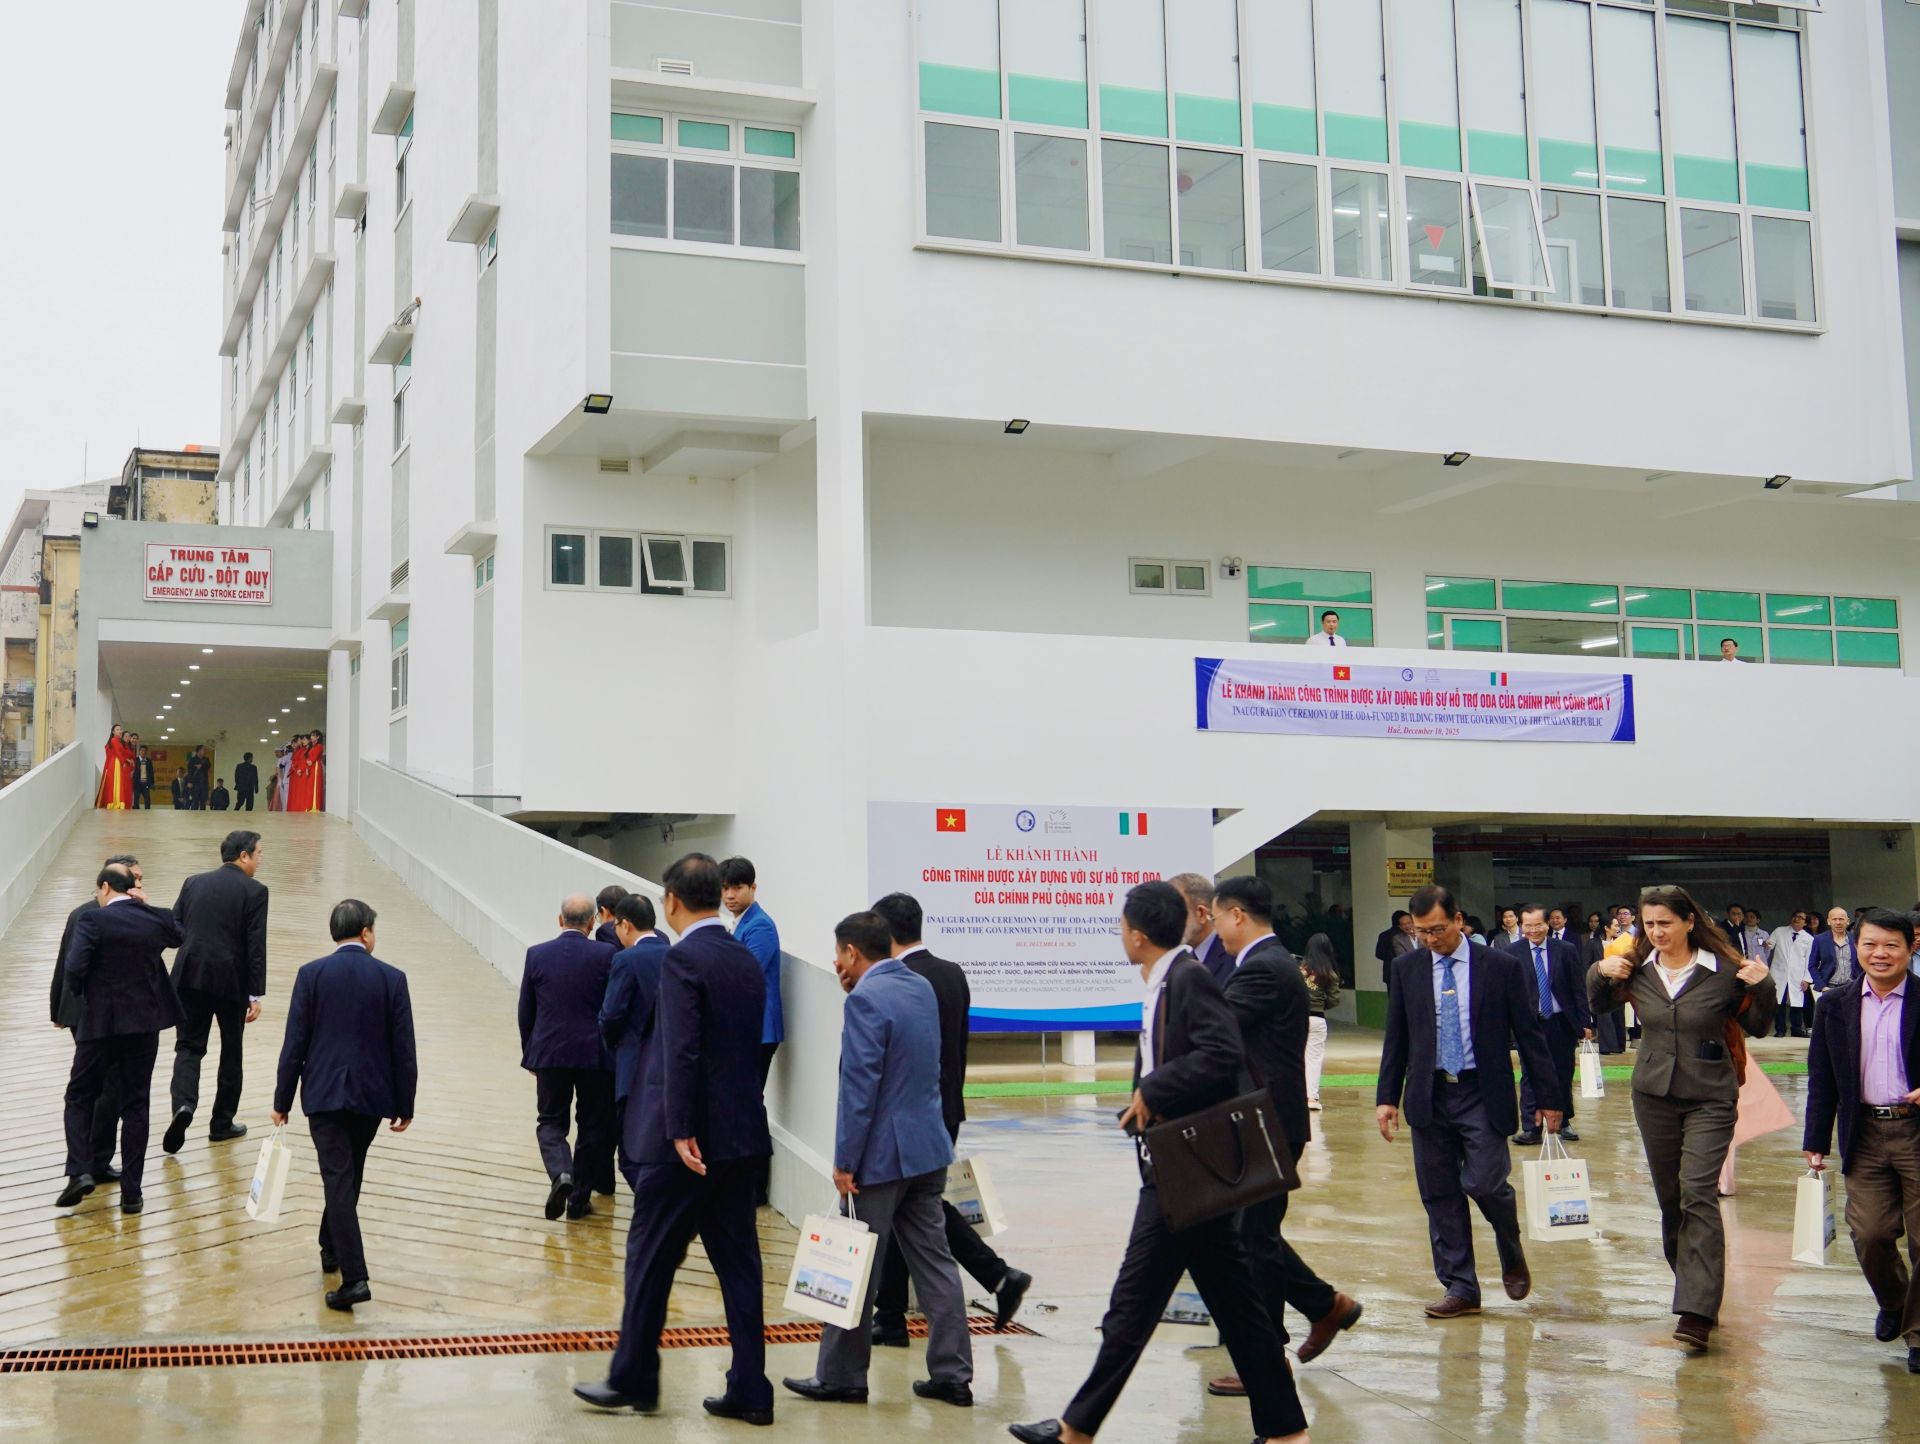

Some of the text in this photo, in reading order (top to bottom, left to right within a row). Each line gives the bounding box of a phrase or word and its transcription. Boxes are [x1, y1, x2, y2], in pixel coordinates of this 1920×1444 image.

[170, 549, 249, 563] TRUNG TÂM
[148, 560, 174, 582] CẤP
[180, 563, 205, 583] CỨU
[216, 566, 240, 588] ĐỘT
[245, 570, 269, 588] QUỴ
[152, 586, 265, 600] EMERGENCY AND STROKE CENTER
[1222, 678, 1611, 713] LỄ KHÁNH THÀNH CÔNG TRÌNH ĐƯỢC XÂY DỰNG VỚI SỰ HỖ TRỢ ODA CỦA CHÍNH PHỦ CỘNG HÒA Ý
[1232, 706, 1604, 727] INAUGURATION CEREMONY OF THE ODA-FUNDED BUILDING FROM THE GOVERNMENT OF THE ITALIAN REPUBLIC
[1403, 726, 1433, 736] December
[1445, 727, 1460, 736] 2025
[1006, 845, 1051, 861] KHÁNH
[1054, 846, 1098, 862] THÀNH
[922, 866, 951, 882] CÔNG
[954, 867, 985, 883] TRÌNH
[987, 869, 1015, 886] ĐƯỢC
[1018, 867, 1037, 883] XÂY
[1040, 869, 1067, 887] DỰNG
[1070, 868, 1086, 884] VỚI
[1089, 870, 1103, 886] SỰ
[1105, 866, 1119, 884] HỖ
[974, 887, 995, 904] CỦA
[998, 888, 1029, 905] CHÍNH
[1032, 887, 1052, 905] PHỦ
[1055, 889, 1082, 908] CỘNG
[1085, 889, 1105, 905] HÒA
[926, 915, 1121, 924] INAUGURATION CEREMONY OF THE ODA-FUNDED
[941, 926, 966, 934] FROM
[967, 926, 984, 934] THE
[985, 926, 1042, 935] GOVERNMENT
[1044, 927, 1056, 935] OF
[1058, 927, 1072, 935] THE
[1075, 927, 1107, 935] ITALIAN
